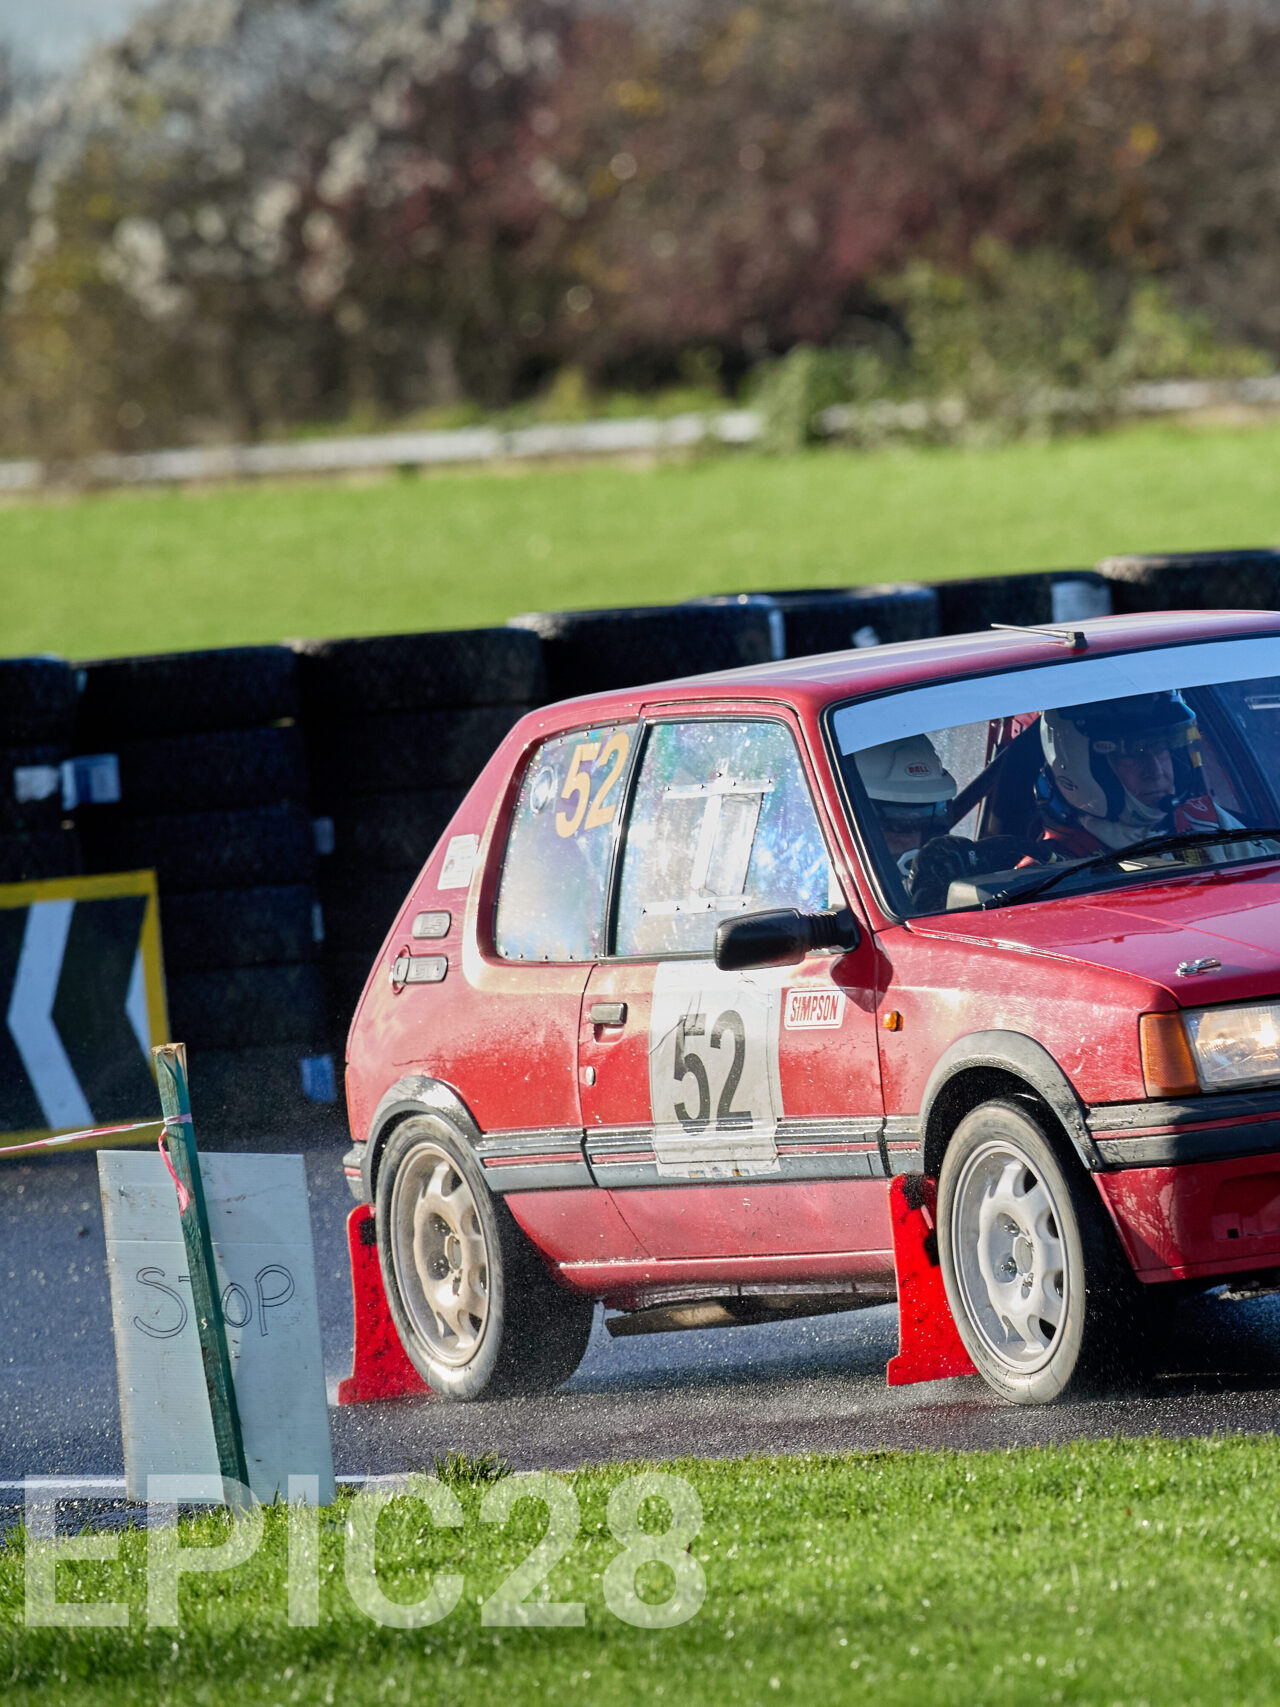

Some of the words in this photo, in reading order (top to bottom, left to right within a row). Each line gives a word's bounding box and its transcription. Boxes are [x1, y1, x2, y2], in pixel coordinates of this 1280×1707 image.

[555, 733, 630, 838] 52
[790, 994, 840, 1022] SIMPSON
[673, 1009, 754, 1136] 52
[134, 1264, 295, 1339] SOP
